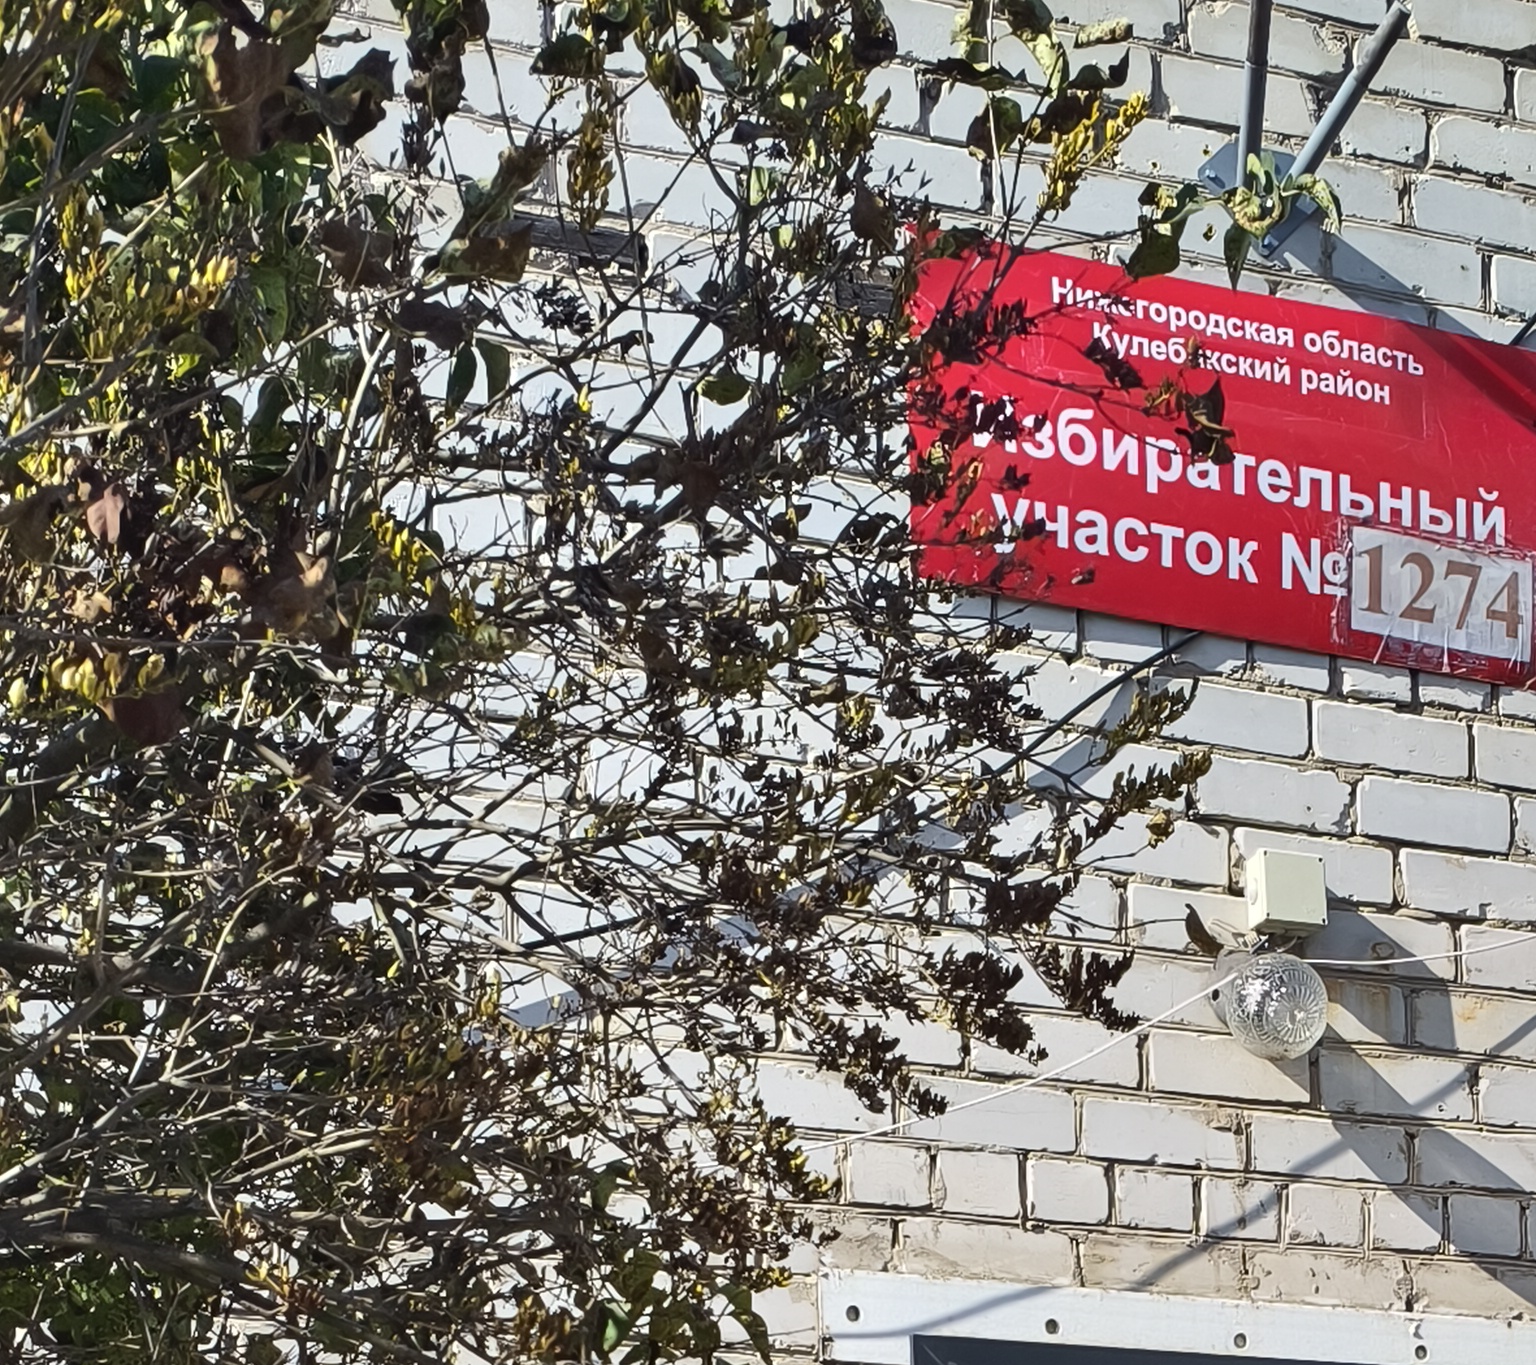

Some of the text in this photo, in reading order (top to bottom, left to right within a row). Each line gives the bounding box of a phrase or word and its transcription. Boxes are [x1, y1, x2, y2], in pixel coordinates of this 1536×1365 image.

[1303, 331, 1424, 376] область
[1301, 368, 1390, 405] район
[991, 493, 1259, 585] участок
[1355, 544, 1524, 640] 1274
